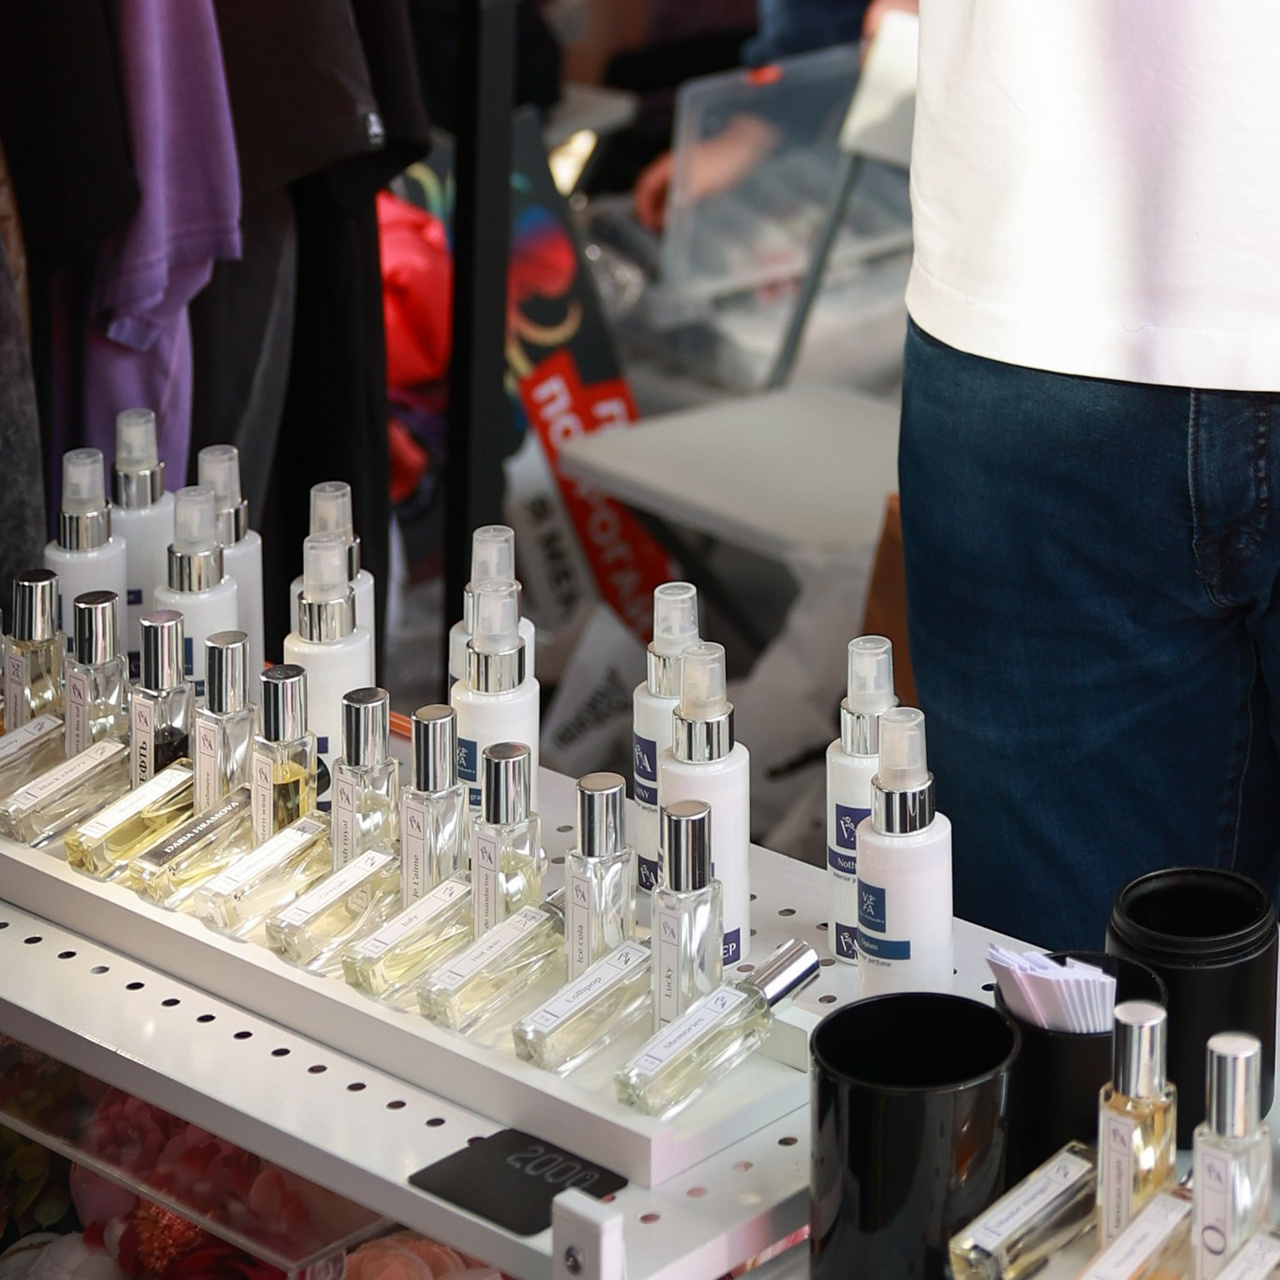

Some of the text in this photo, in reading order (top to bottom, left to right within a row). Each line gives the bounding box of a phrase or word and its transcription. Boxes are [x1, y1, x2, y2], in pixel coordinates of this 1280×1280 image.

[139, 741, 148, 784] ЕФТЬ
[164, 801, 240, 853] DARIA HRAMOVA
[837, 857, 857, 870] Noth
[564, 976, 603, 1003] Lollipop
[664, 967, 673, 998] Lucky
[663, 1017, 705, 1050] Memories
